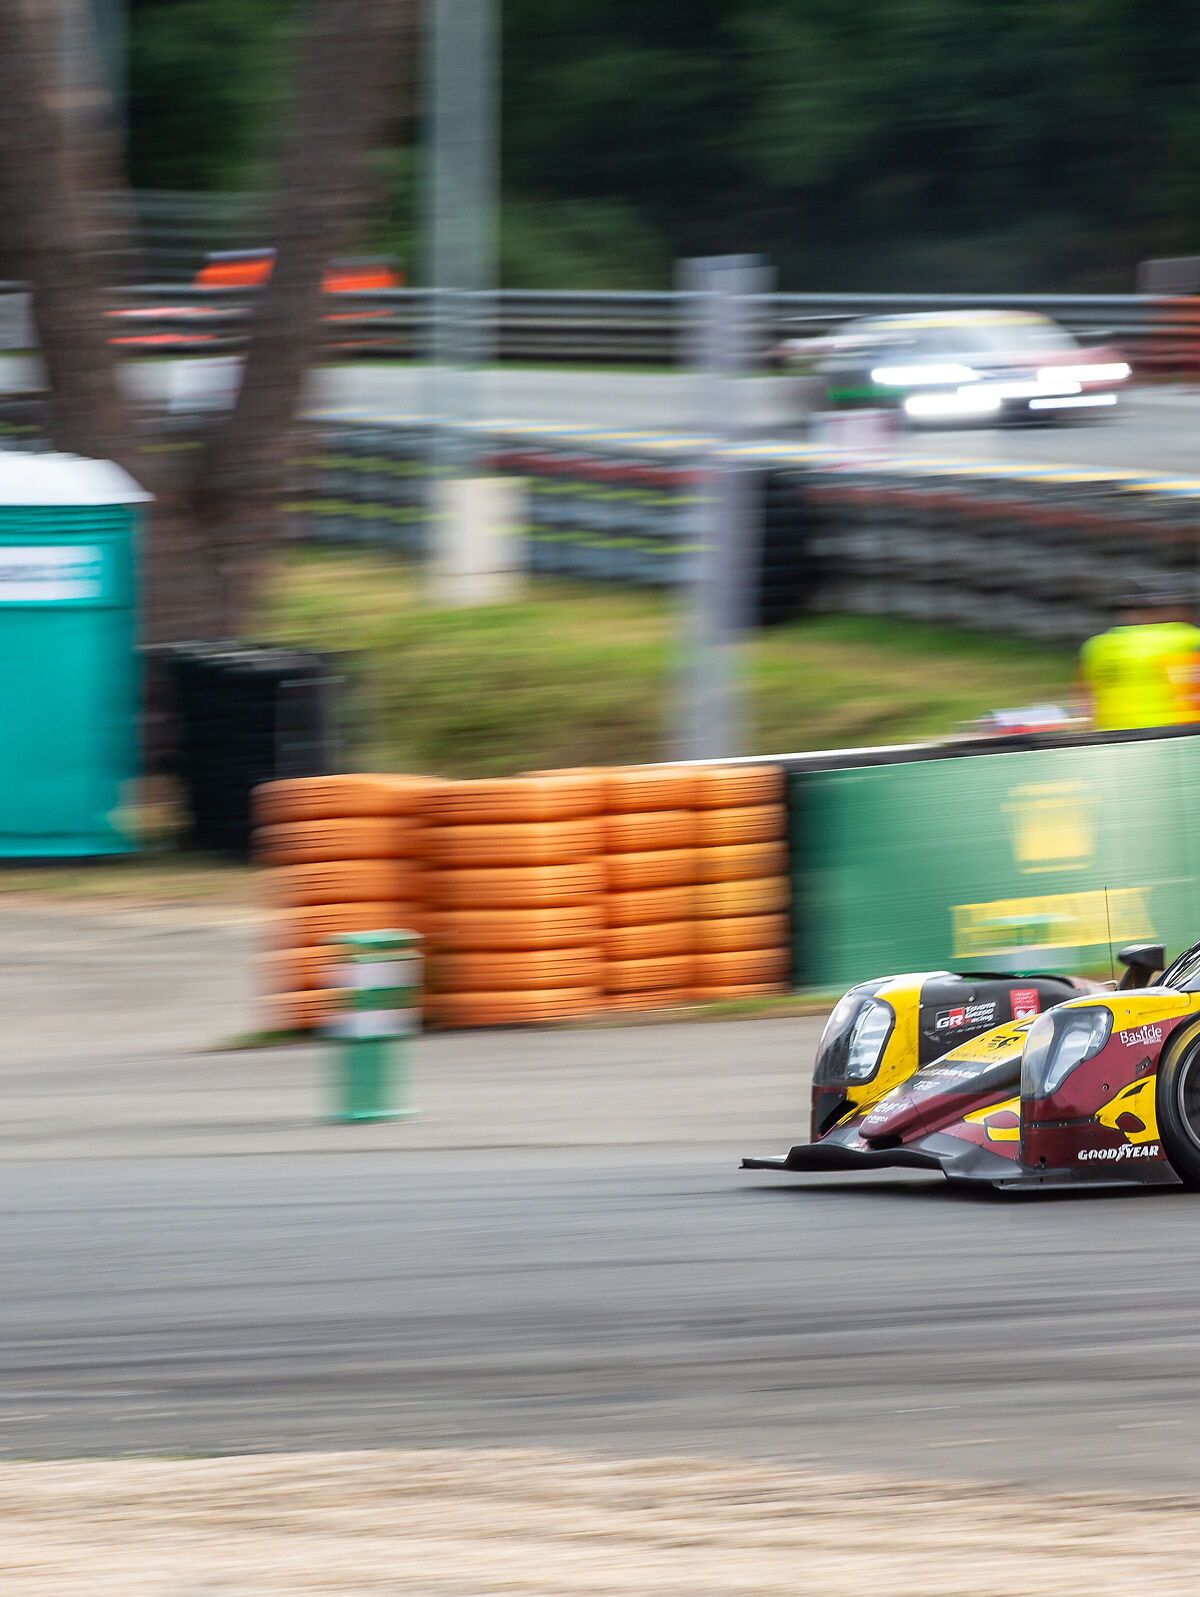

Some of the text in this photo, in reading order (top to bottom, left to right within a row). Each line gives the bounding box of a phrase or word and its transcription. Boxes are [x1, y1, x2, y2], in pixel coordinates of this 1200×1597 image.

[936, 1015, 963, 1029] GR
[1120, 1025, 1162, 1043] Bastide
[1078, 1144, 1159, 1162] GOODYEAR
